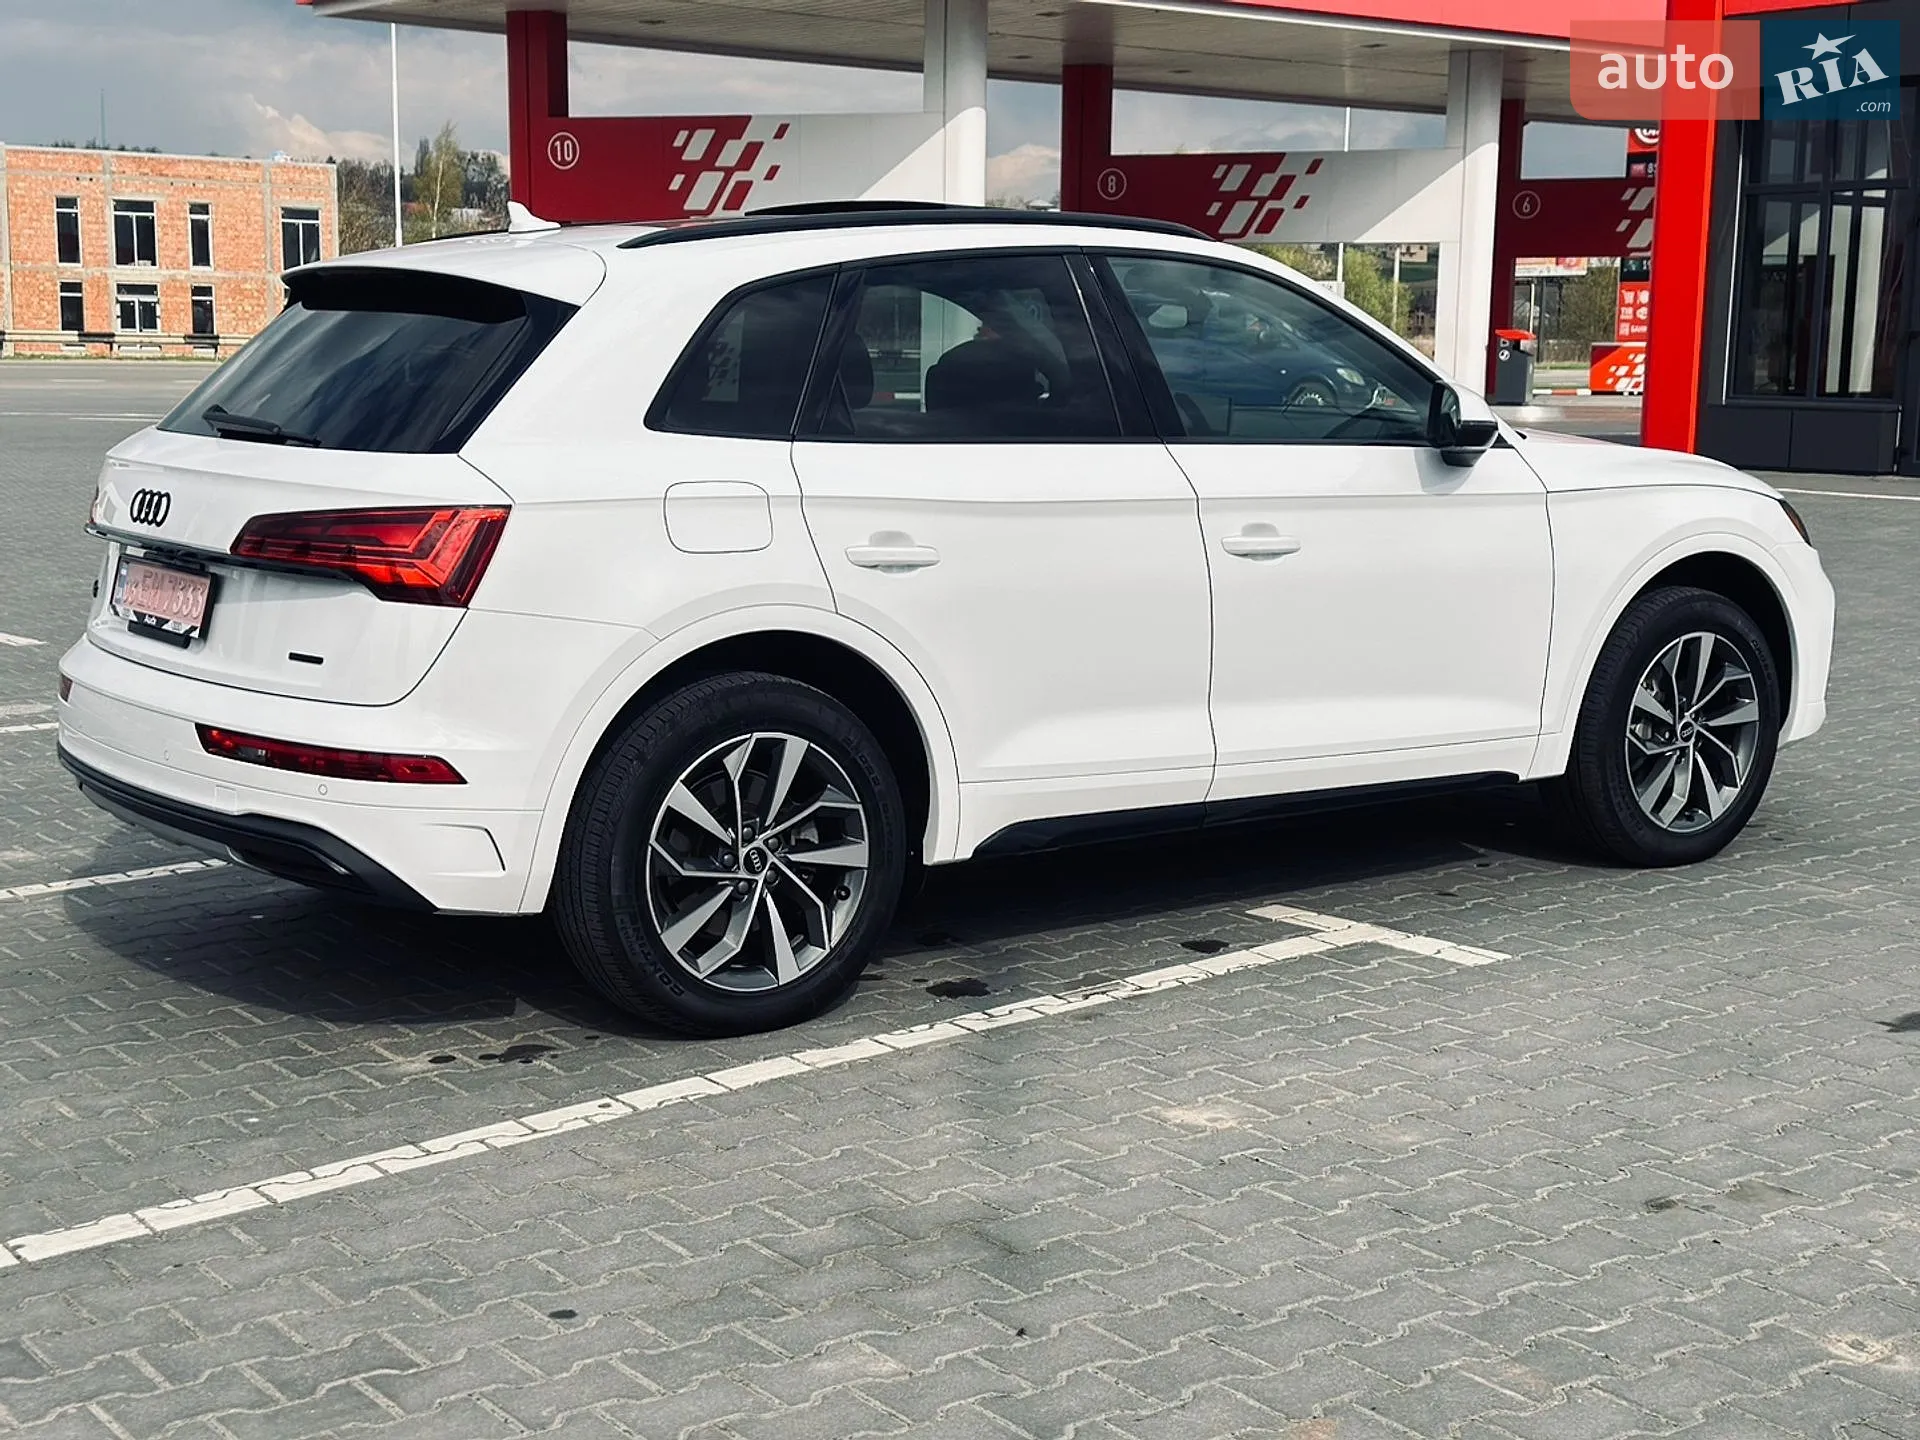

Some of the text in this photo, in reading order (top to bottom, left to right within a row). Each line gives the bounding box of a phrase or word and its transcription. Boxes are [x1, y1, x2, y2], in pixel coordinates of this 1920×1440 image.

[554, 140, 573, 162] 10
[1108, 175, 1116, 193] 8
[1523, 196, 1531, 213] 6
